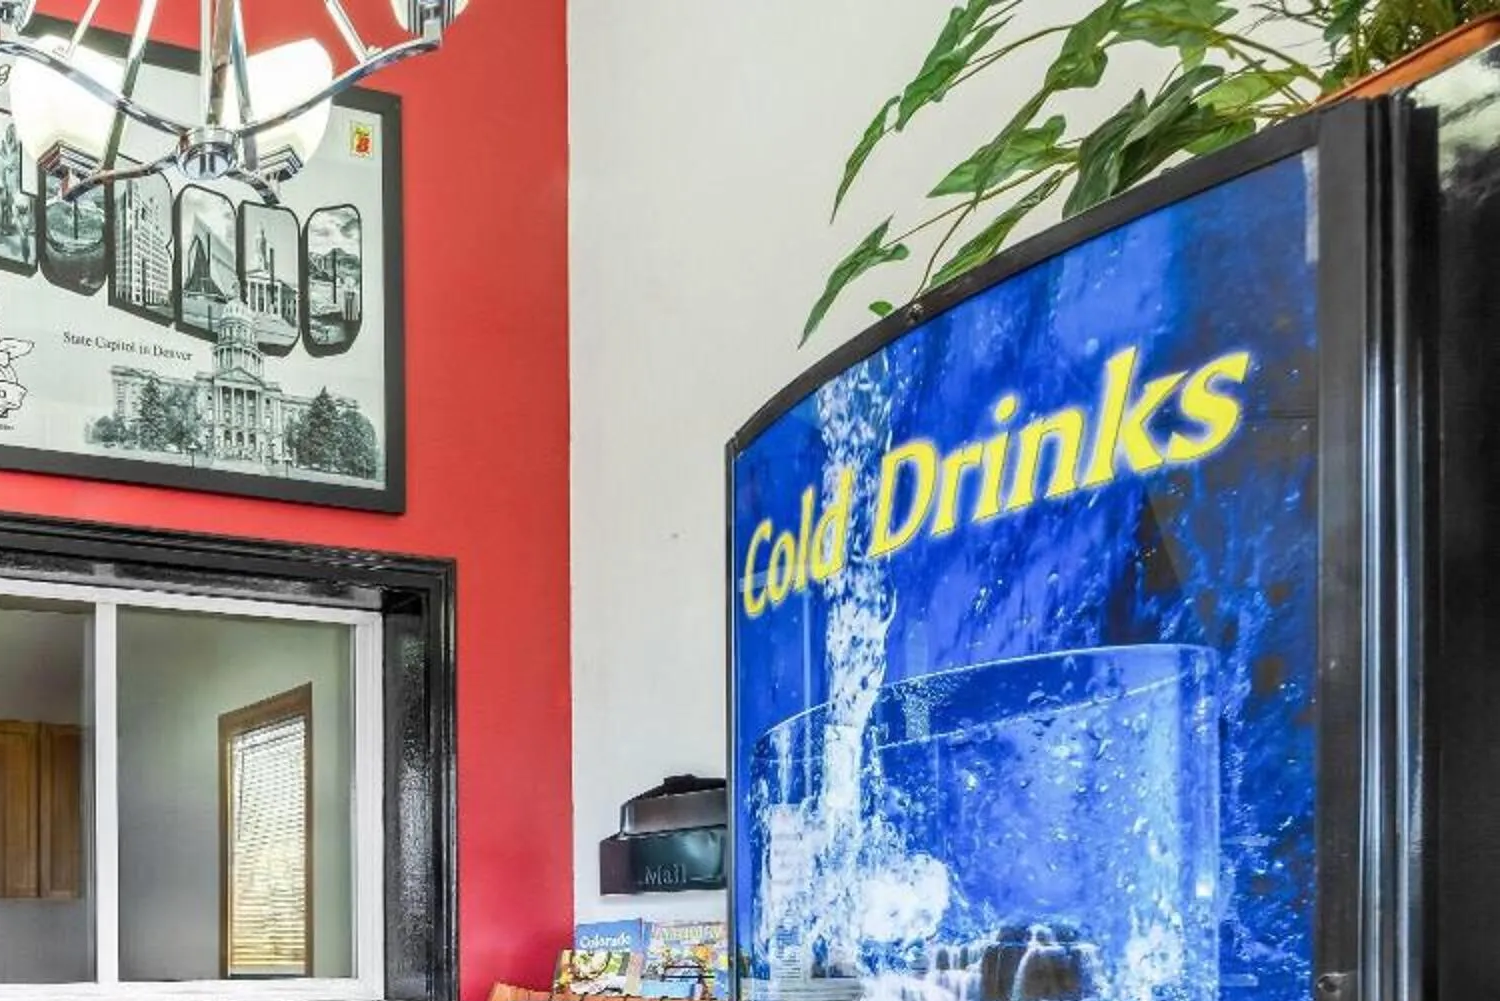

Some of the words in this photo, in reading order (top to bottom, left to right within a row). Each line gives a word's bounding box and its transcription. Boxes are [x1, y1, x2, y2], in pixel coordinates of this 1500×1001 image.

[63, 331, 92, 348] State
[95, 335, 136, 353] Capitol
[139, 341, 151, 355] in
[153, 345, 193, 361] Denver
[743, 466, 854, 618] Cold
[866, 346, 1249, 560] Drinks
[645, 863, 687, 885] Mail
